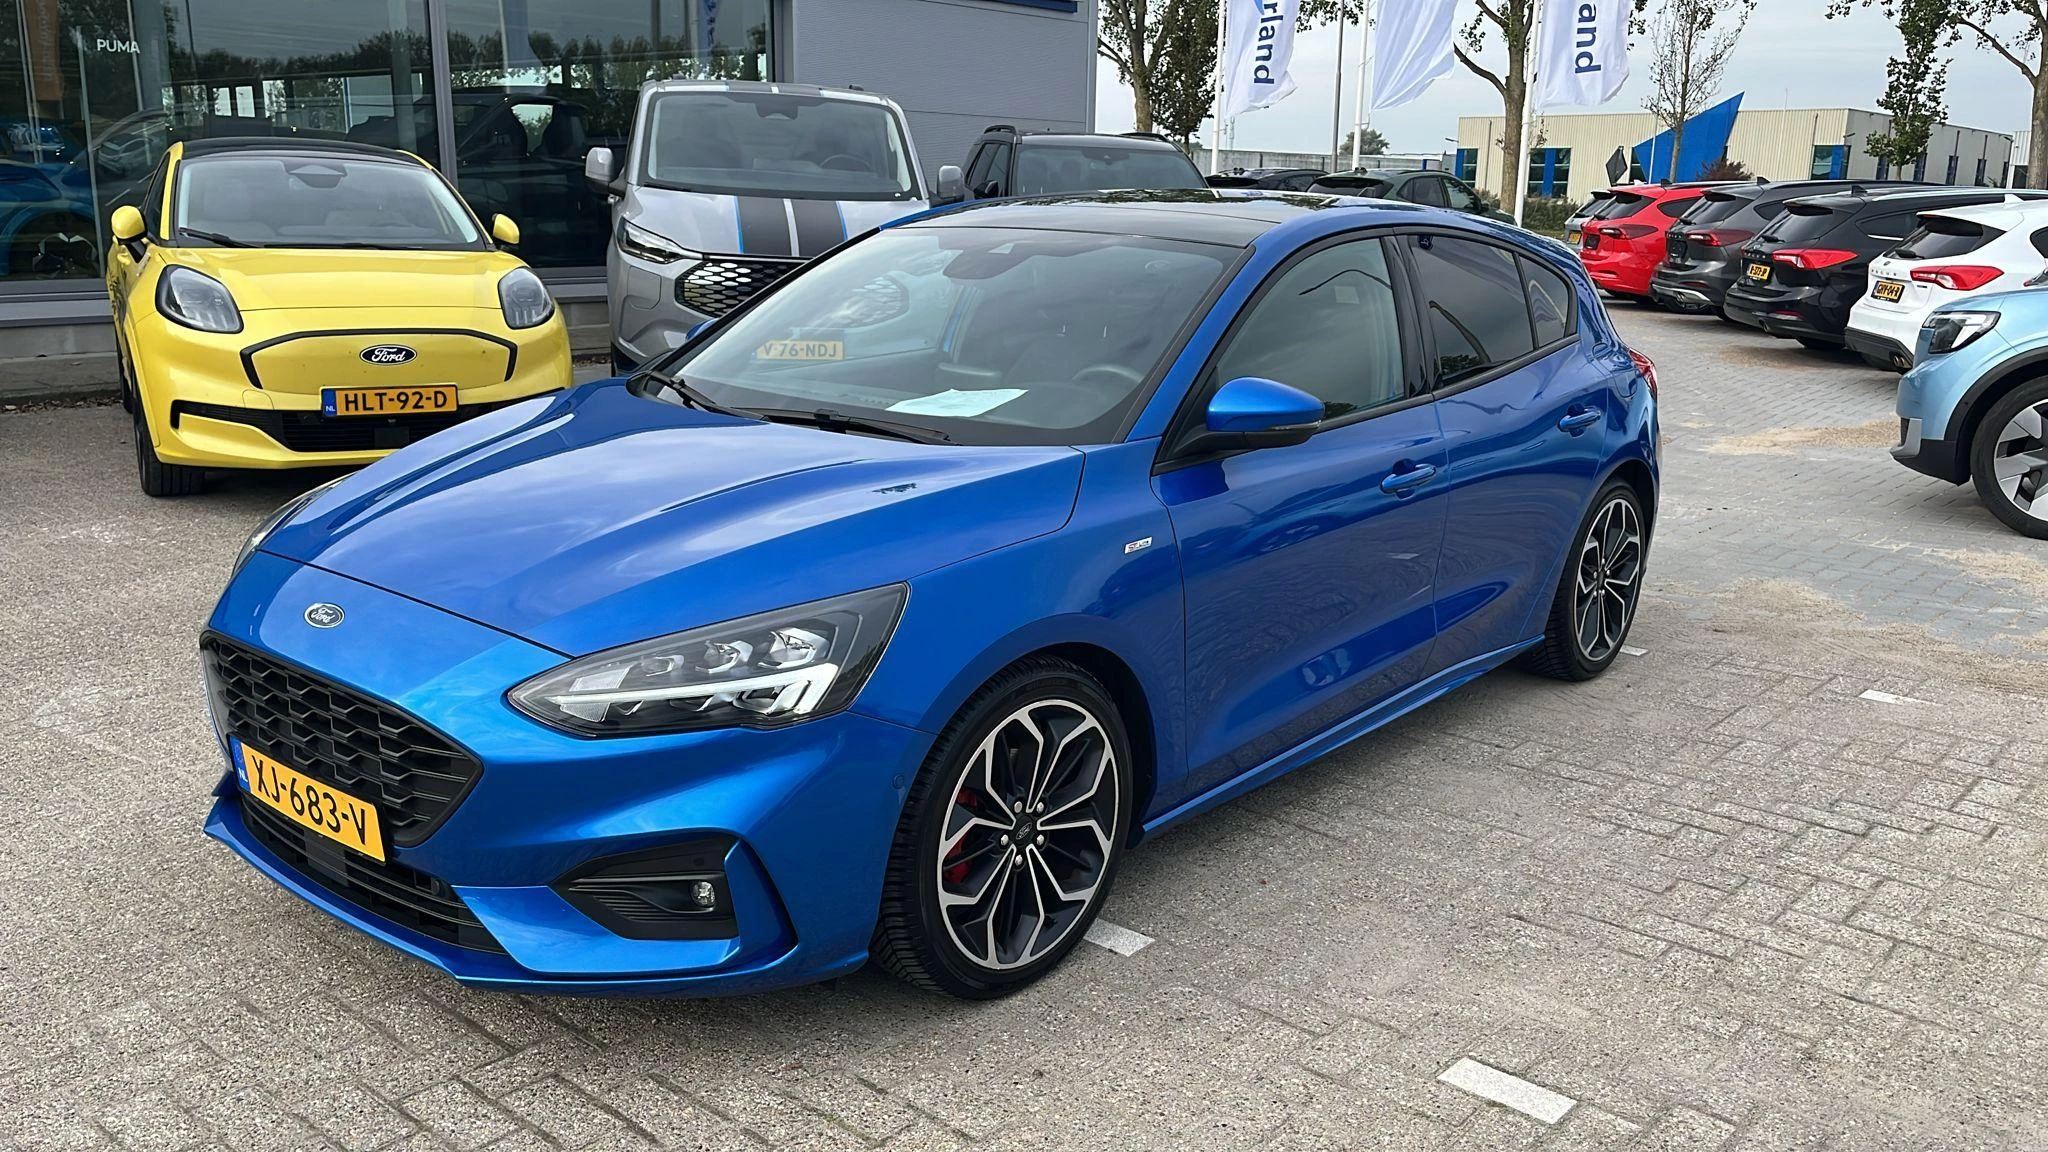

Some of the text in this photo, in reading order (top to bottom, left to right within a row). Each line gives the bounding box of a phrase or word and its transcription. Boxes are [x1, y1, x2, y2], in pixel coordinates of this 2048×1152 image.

[96, 38, 141, 54] PUMA
[371, 347, 406, 362] Ford
[344, 390, 448, 412] HLT-92-D
[310, 607, 336, 623] Ford
[238, 754, 366, 846] NL XJ-683-V
